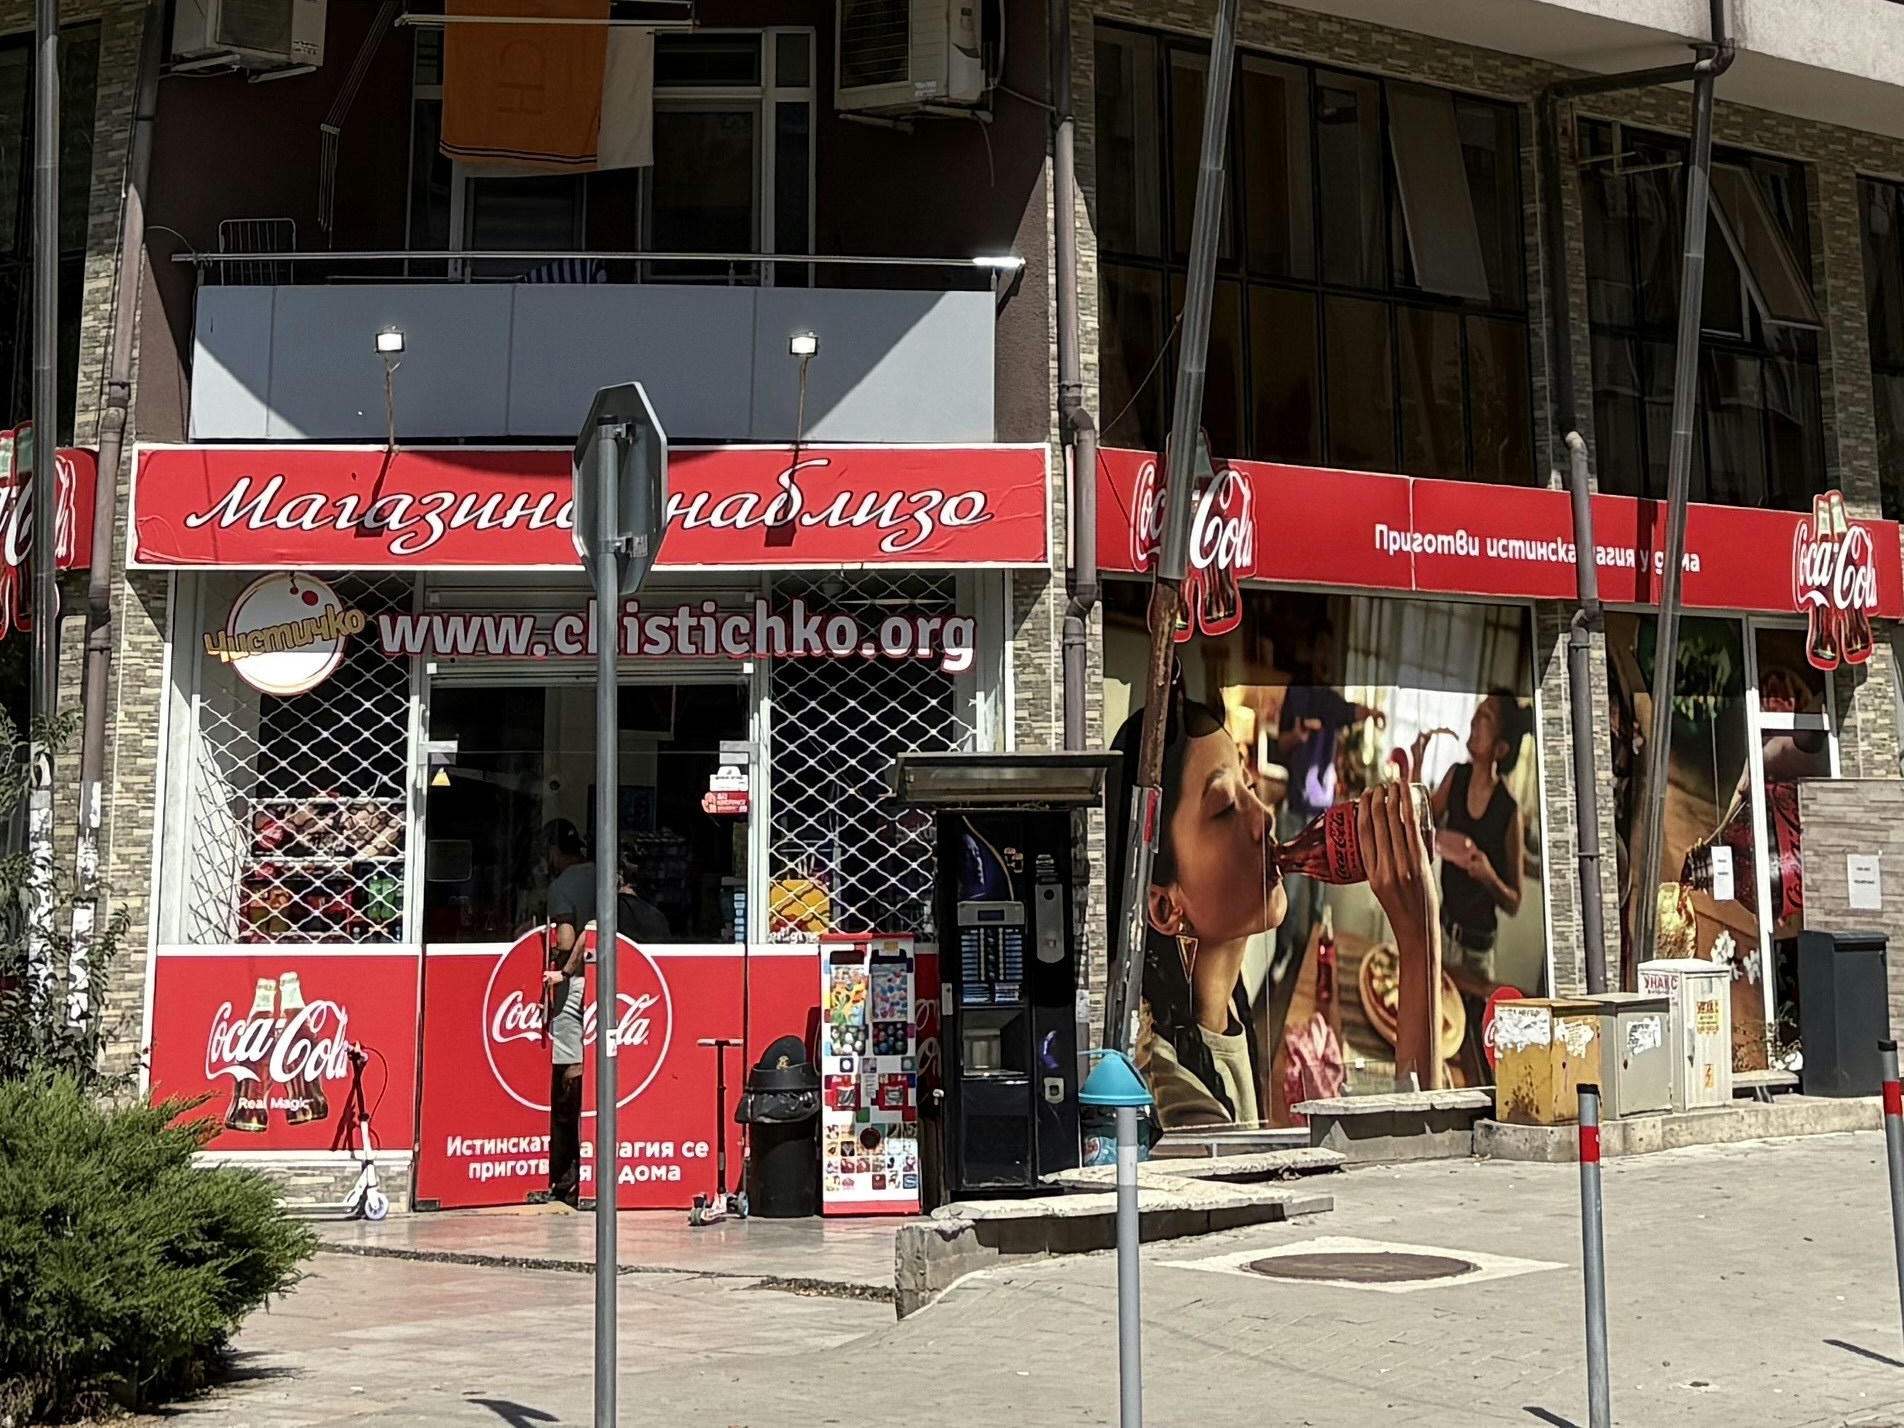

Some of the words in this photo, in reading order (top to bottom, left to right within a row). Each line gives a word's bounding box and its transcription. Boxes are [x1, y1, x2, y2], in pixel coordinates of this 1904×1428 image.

[667, 457, 994, 553] наблизо
[1136, 464, 1253, 570] Coc-Cola
[1374, 523, 1479, 557] Приготви
[1486, 536, 1576, 564] истинска
[1595, 545, 1636, 567] агия
[1798, 523, 1877, 609] Coca-Cola
[203, 604, 366, 663] Чистичко
[205, 1000, 348, 1083] Coca-Cola
[238, 1097, 267, 1110] Real
[271, 1096, 312, 1111] Magic
[616, 1141, 674, 1158] агия
[681, 1141, 709, 1158] се
[618, 1164, 681, 1185] дома
